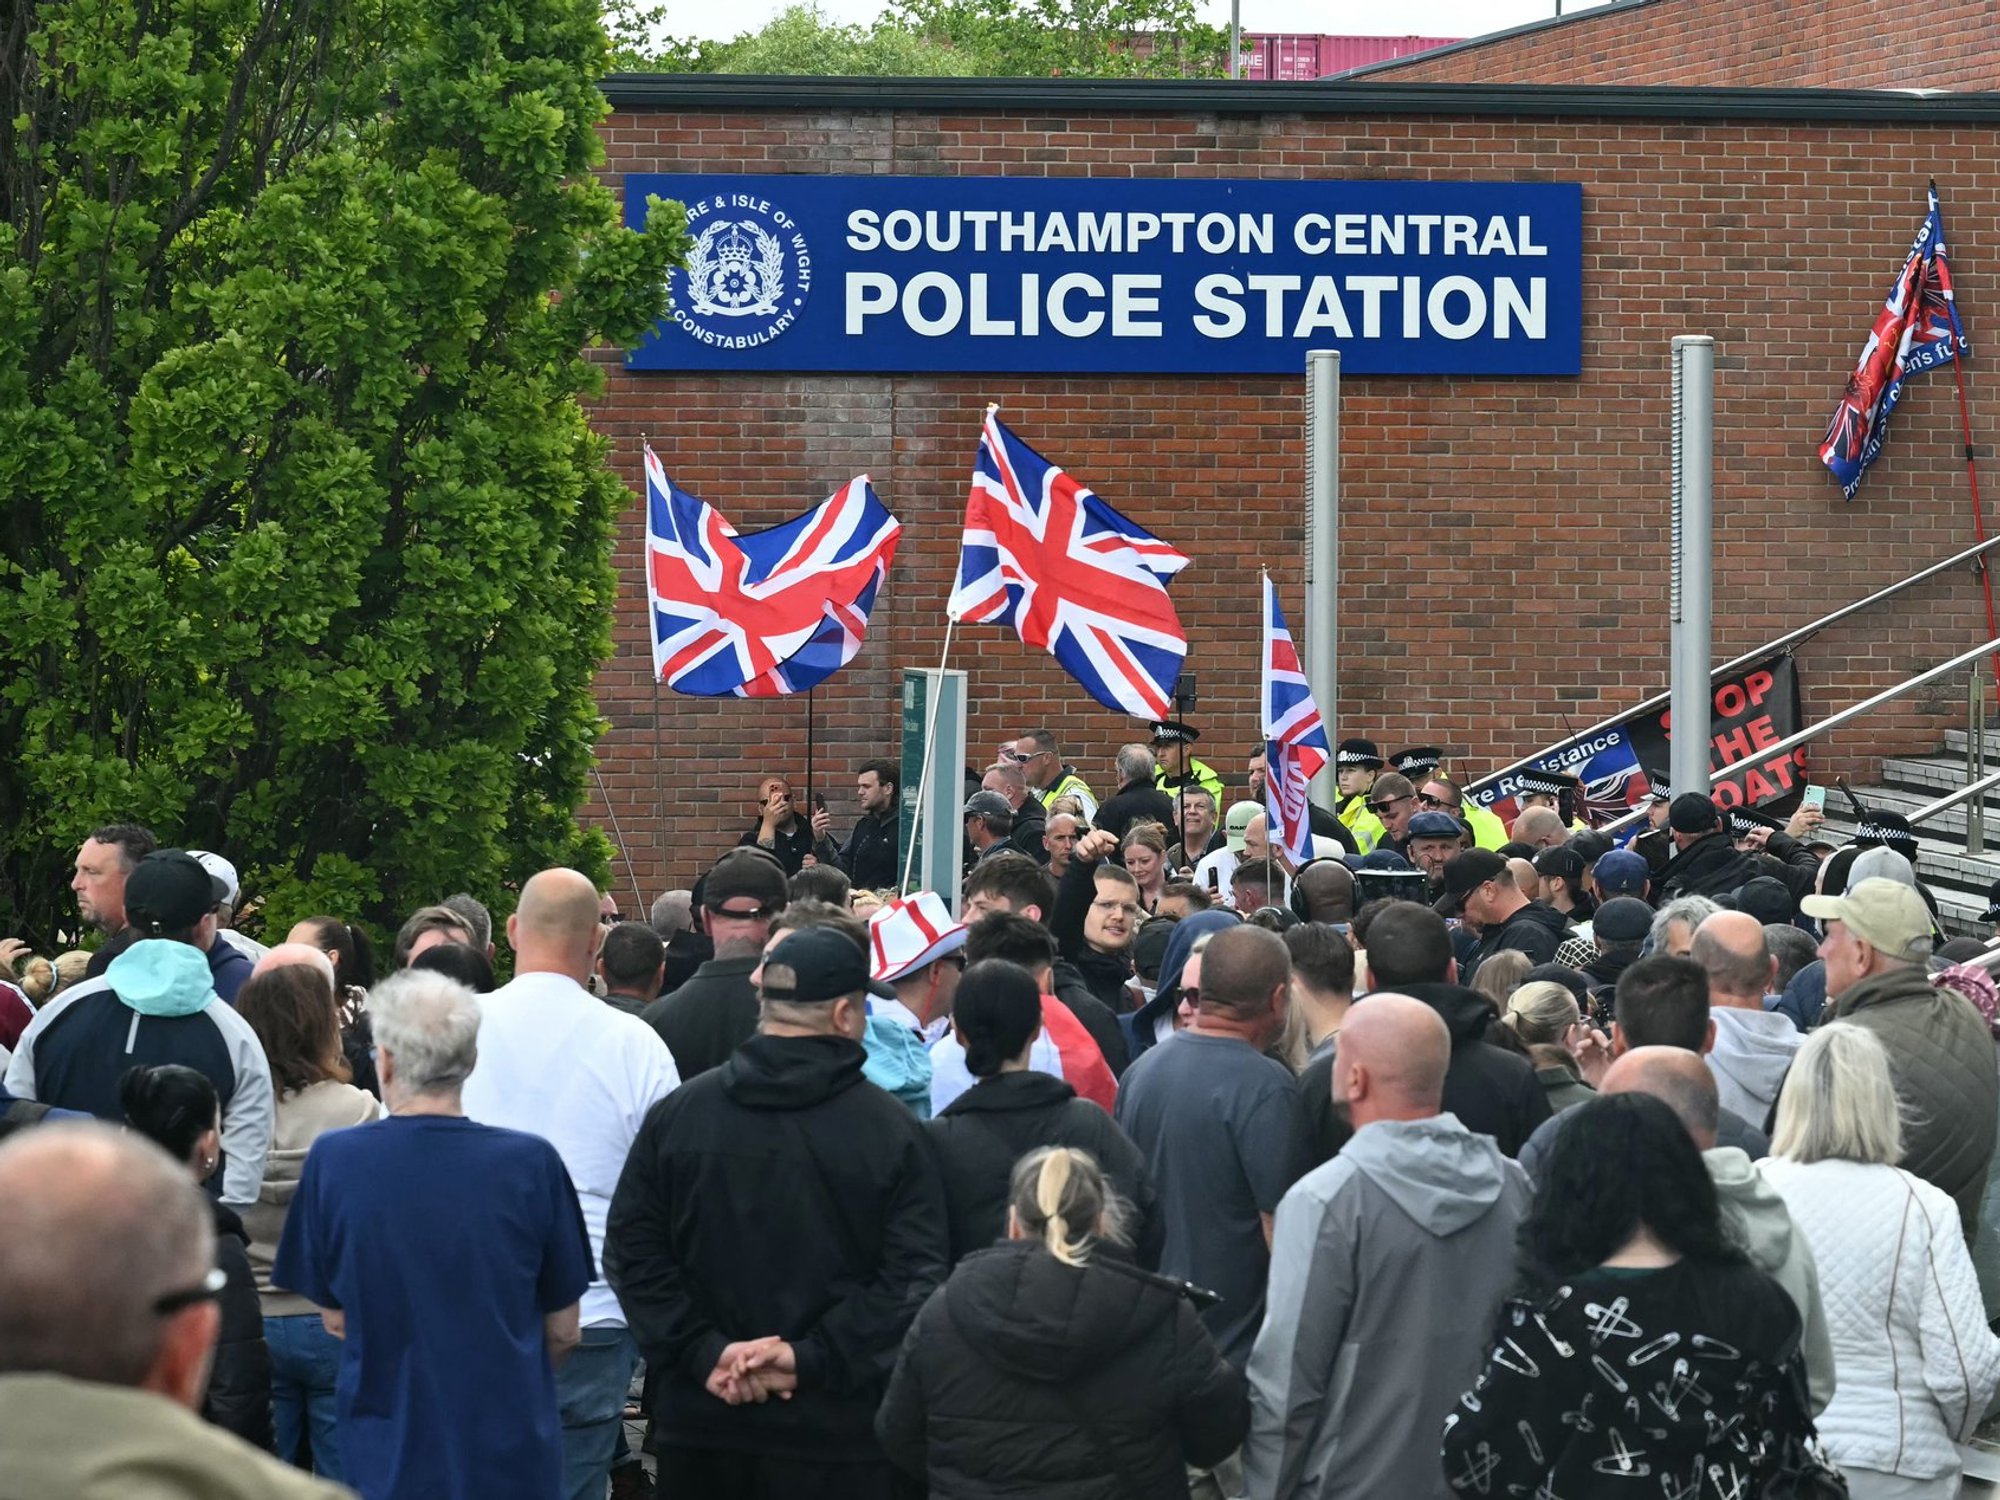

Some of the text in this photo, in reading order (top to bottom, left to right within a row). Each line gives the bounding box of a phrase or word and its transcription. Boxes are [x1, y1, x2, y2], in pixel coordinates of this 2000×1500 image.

[715, 194, 811, 292] & ISLE OF WIGHT
[847, 209, 1548, 256] SOUTHAMPTON CENTRAL
[674, 309, 795, 349] CONSTABULARY
[845, 271, 1548, 339] POLICE STATION
[1497, 731, 1620, 797] Reistance
[1711, 746, 1809, 811] OATS
